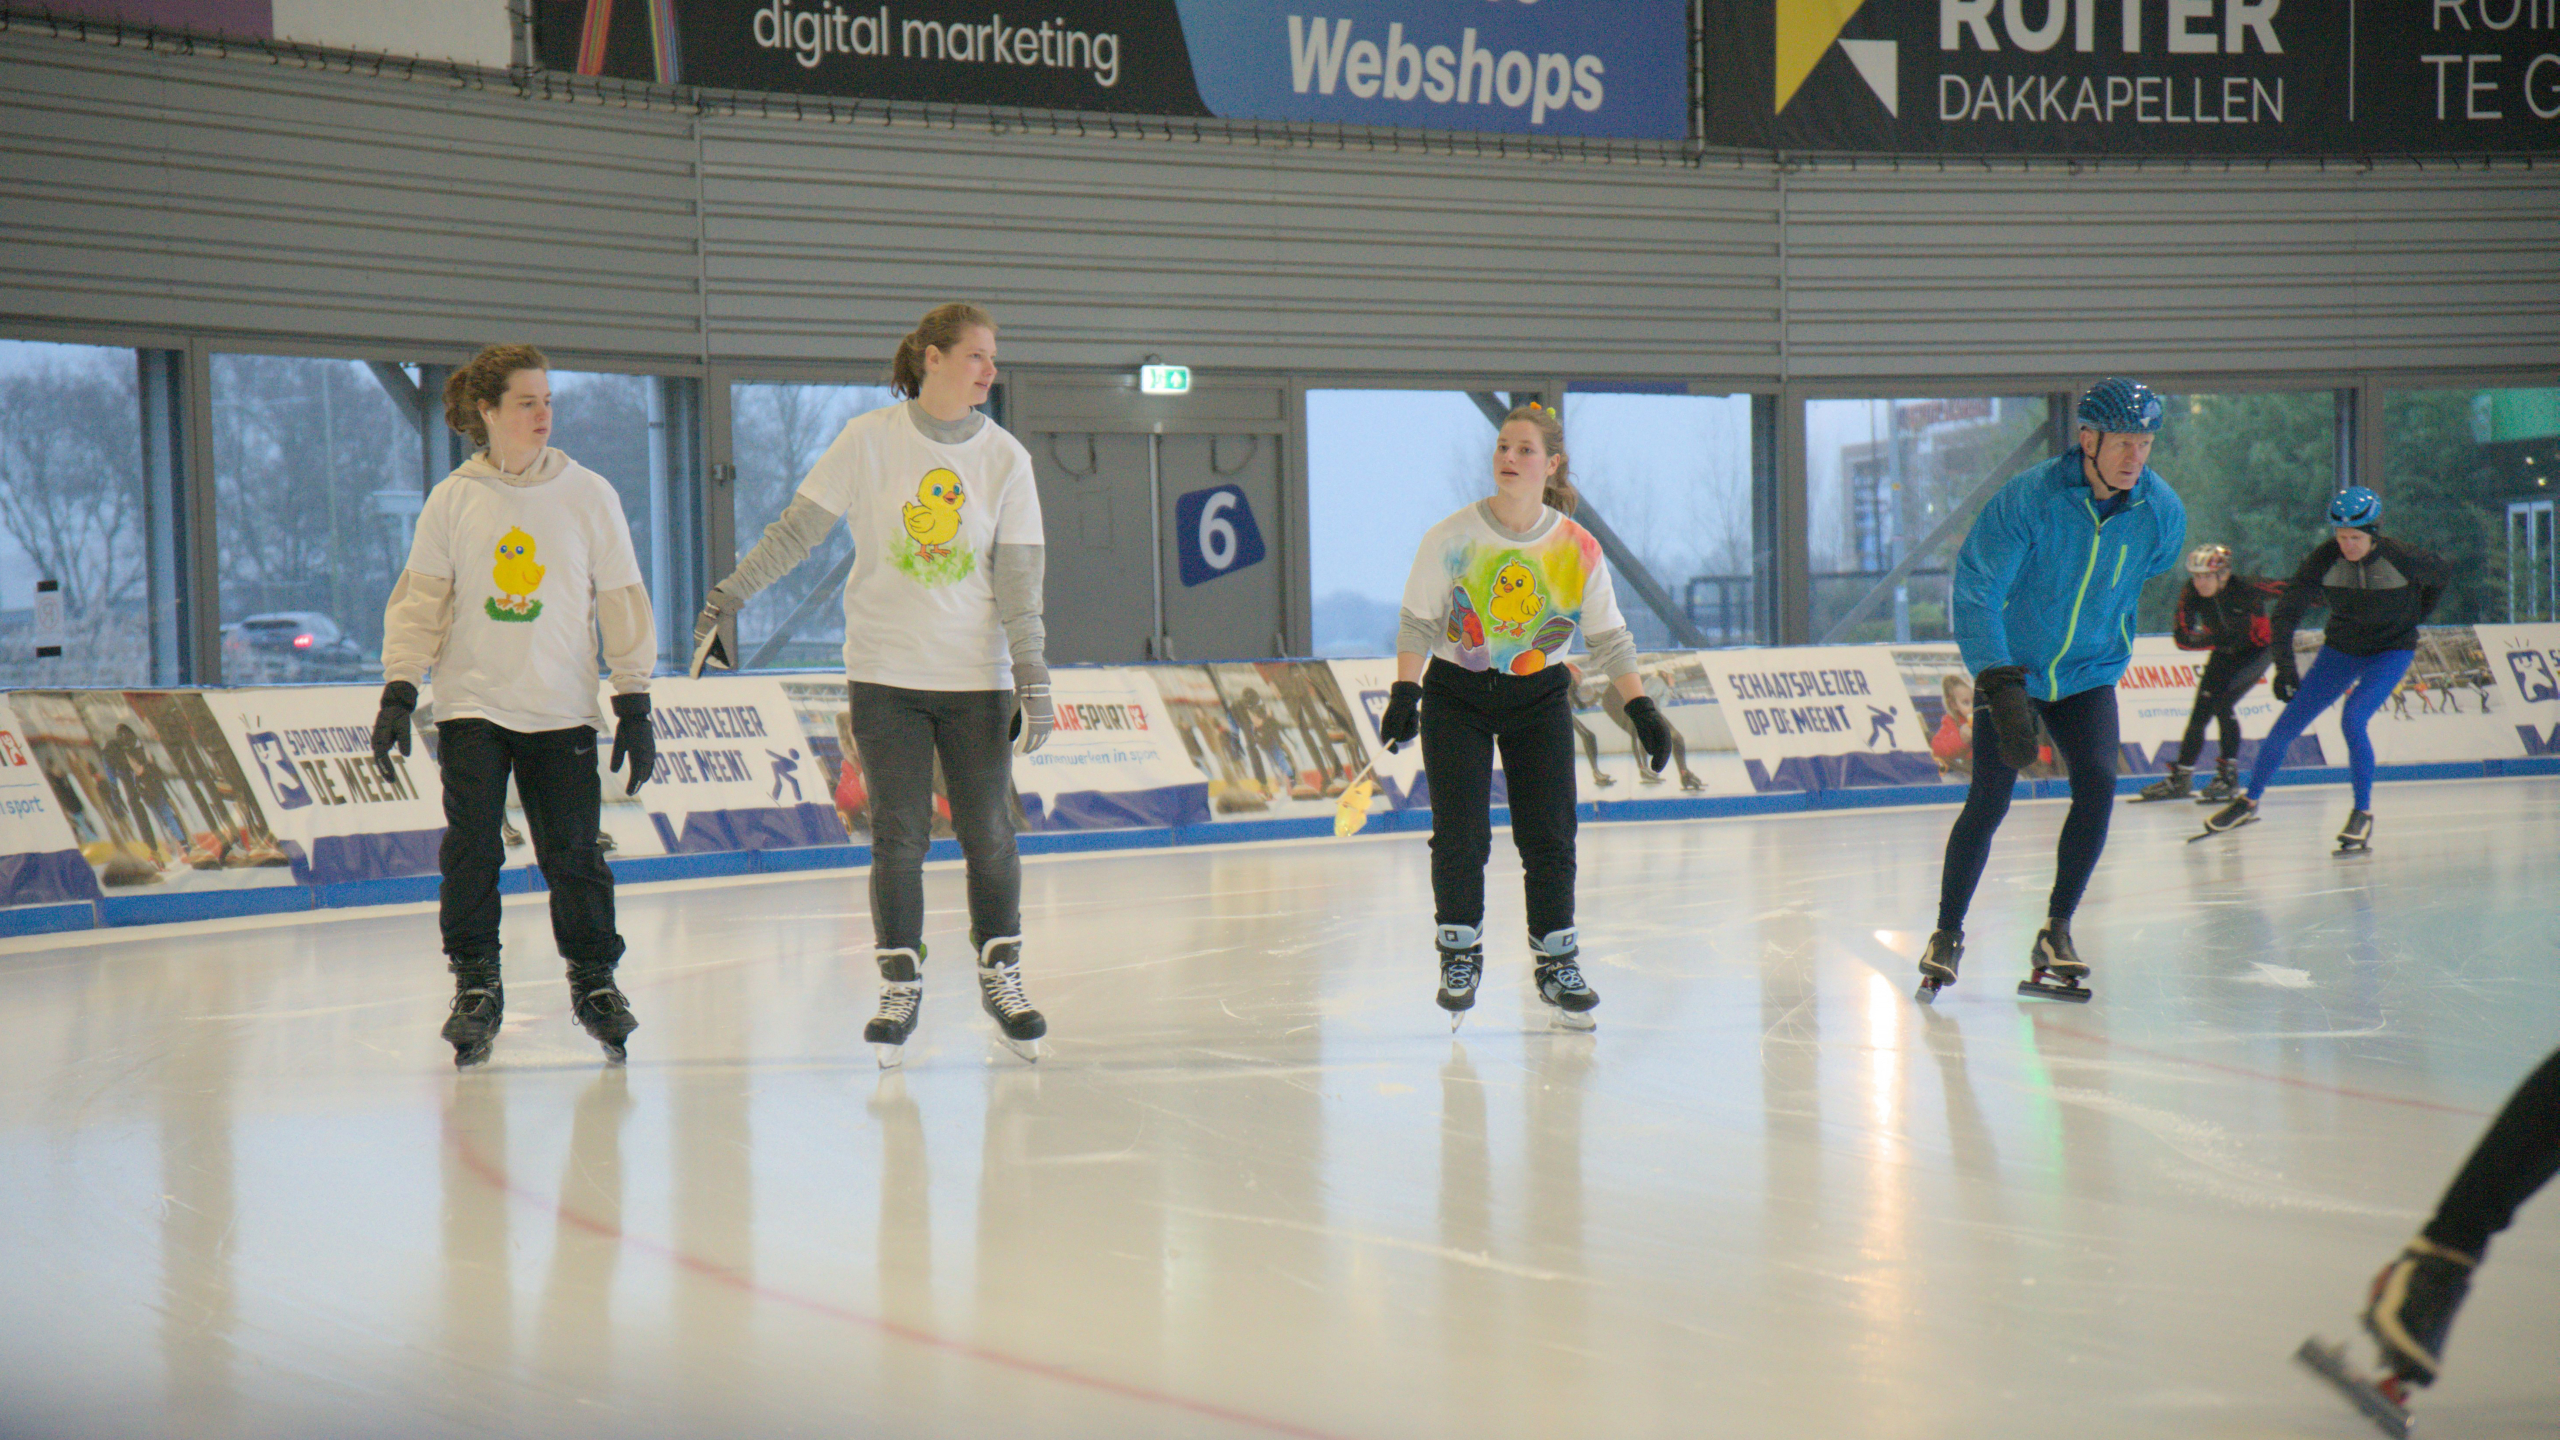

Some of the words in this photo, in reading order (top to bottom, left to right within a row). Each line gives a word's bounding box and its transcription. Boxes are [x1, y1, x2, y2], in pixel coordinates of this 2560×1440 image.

[753, 0, 890, 68] digital
[902, 11, 1119, 87] marketing
[1288, 14, 1605, 125] Webshops
[2420, 54, 2503, 120] TE
[1940, 74, 2284, 123] DAKKAPELLEN
[1198, 491, 1237, 570] 6
[1728, 669, 1871, 700] SCHAATSPLEZIER
[1743, 709, 1770, 736] OP
[1769, 707, 1795, 735] DE
[1789, 704, 1851, 734] MEENT
[666, 751, 698, 784] DE
[692, 749, 753, 783] MEENT
[1029, 750, 1110, 767] samenwerken
[1113, 748, 1127, 763] in
[298, 759, 347, 806] DE
[6, 796, 44, 819] sport
